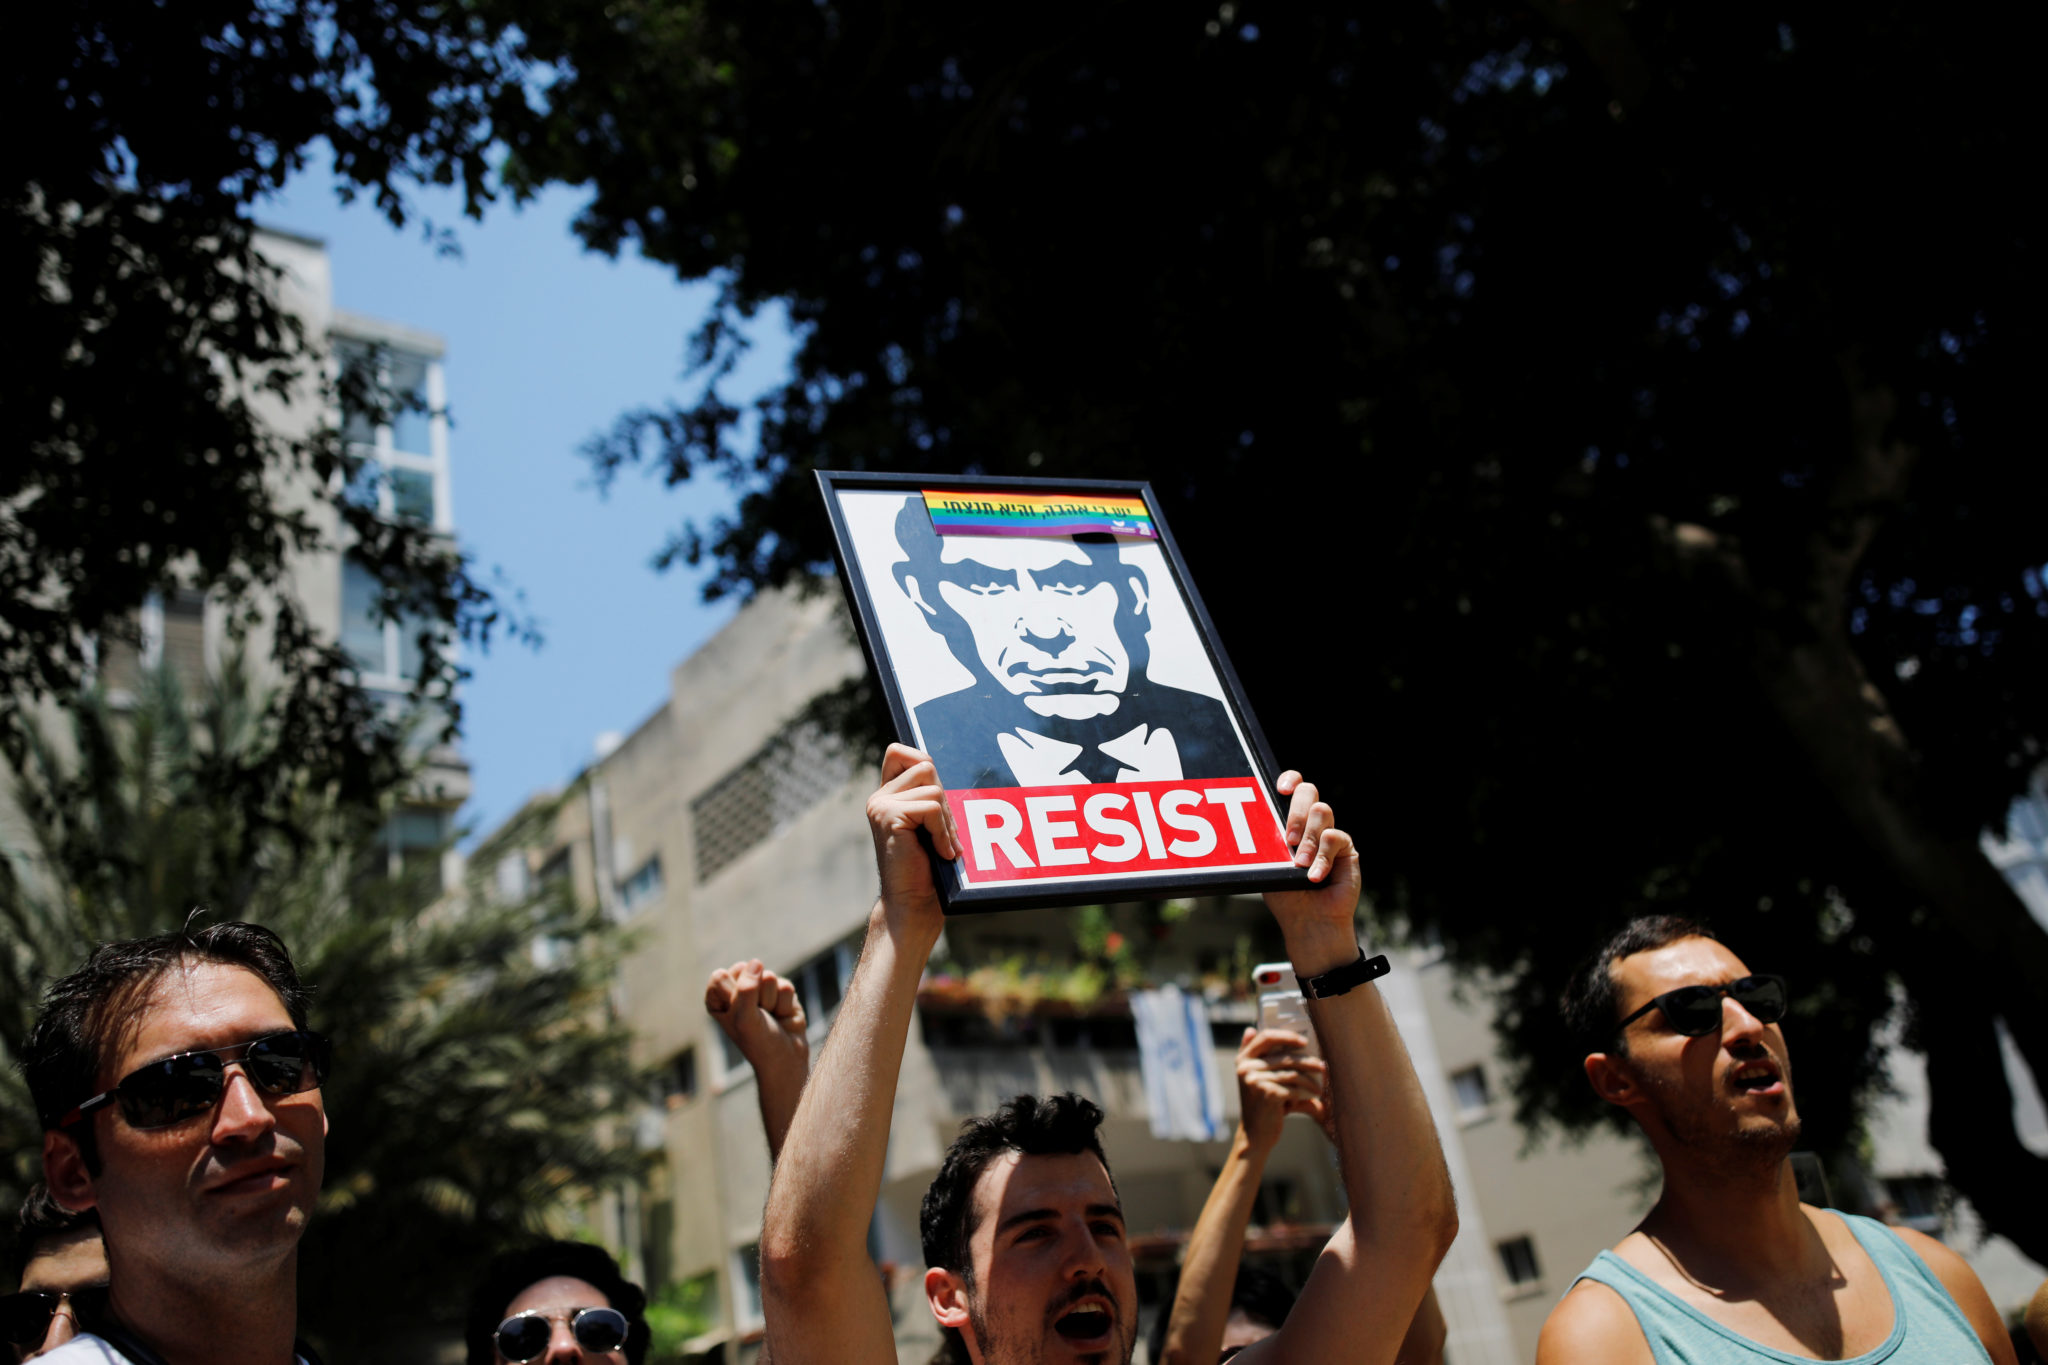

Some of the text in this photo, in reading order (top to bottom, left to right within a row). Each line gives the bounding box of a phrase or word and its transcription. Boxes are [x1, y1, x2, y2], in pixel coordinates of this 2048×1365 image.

[943, 500, 995, 515] תנצח!
[998, 503, 1036, 517] והיא
[1041, 504, 1090, 520] אהבה,
[1112, 506, 1132, 518] יש
[963, 787, 1257, 871] RESIST
